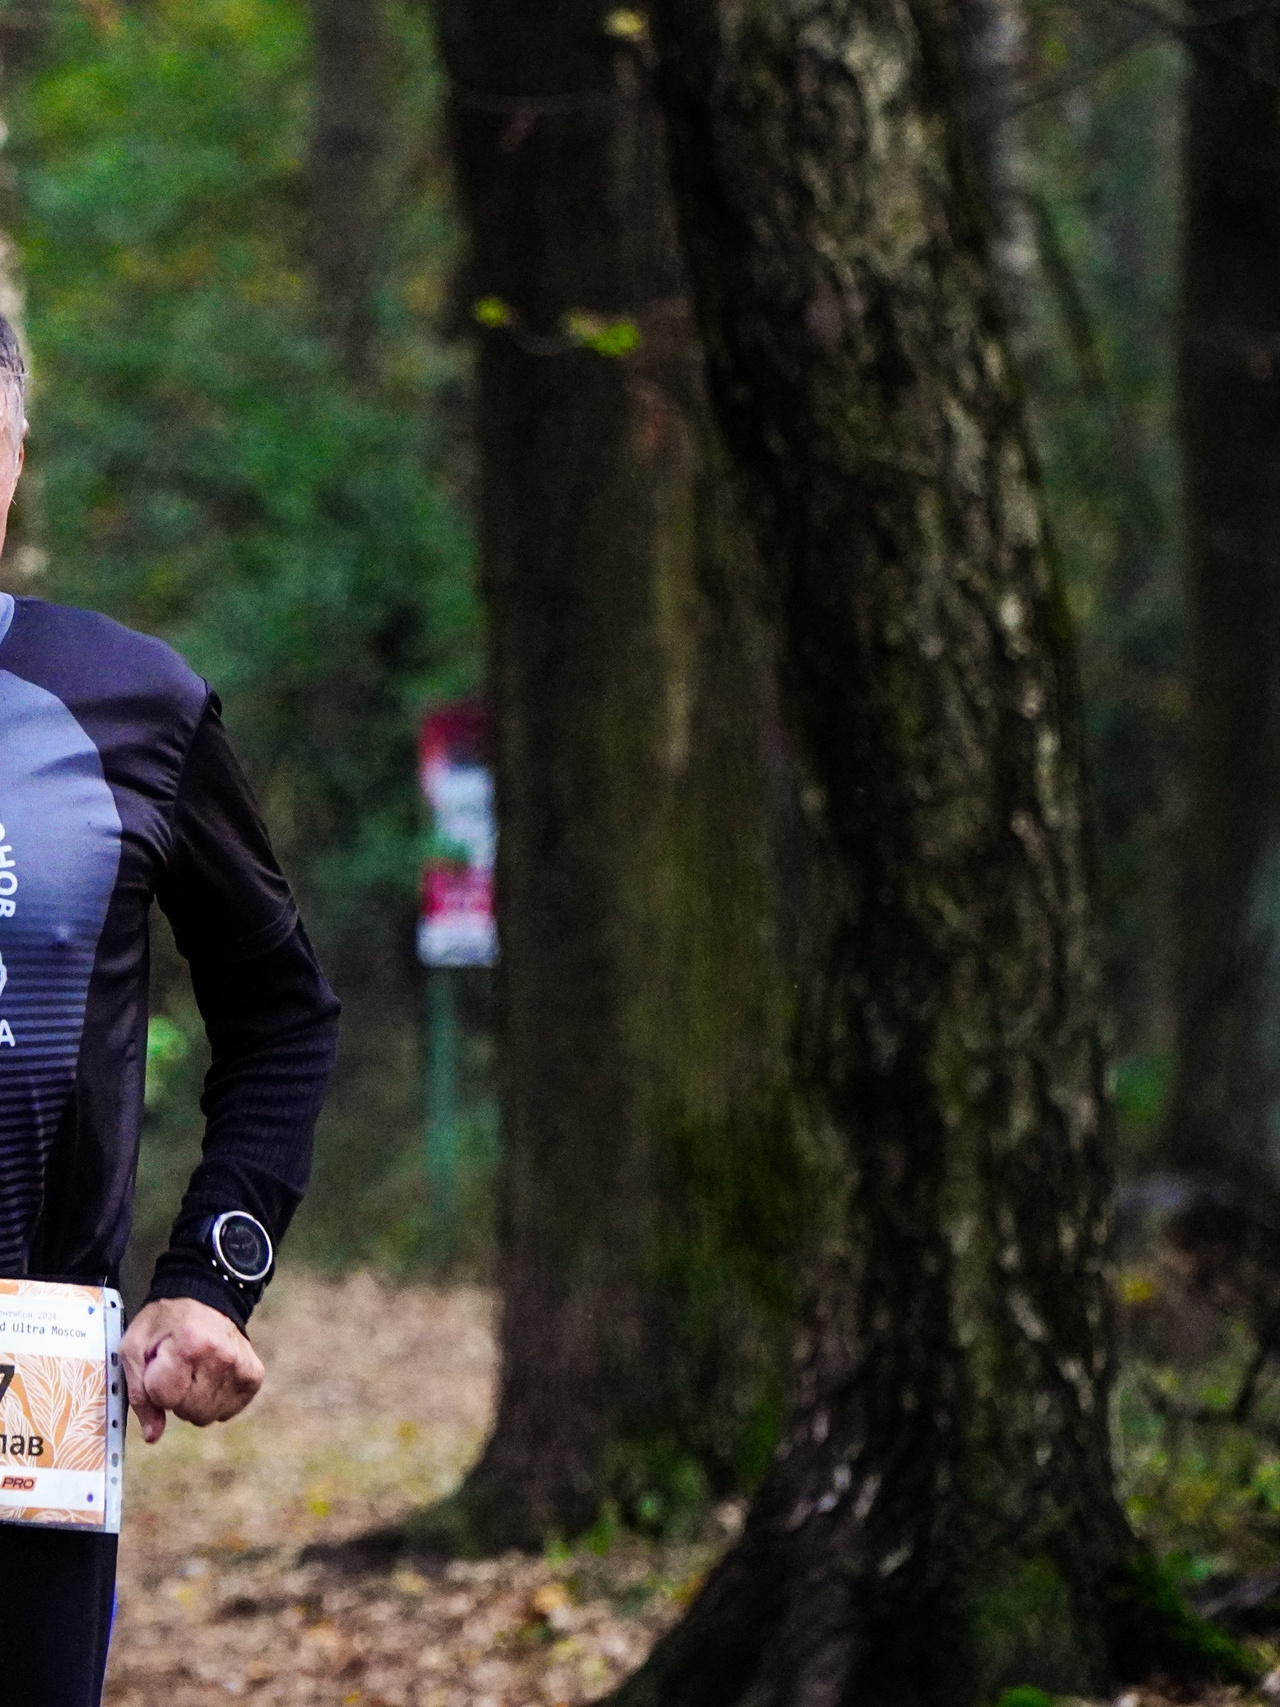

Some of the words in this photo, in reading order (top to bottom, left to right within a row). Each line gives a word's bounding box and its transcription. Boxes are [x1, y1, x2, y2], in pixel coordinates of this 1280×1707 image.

[13, 1323, 45, 1334] Ultra
[51, 1326, 86, 1338] Moscow
[2, 1478, 34, 1489] PRO
